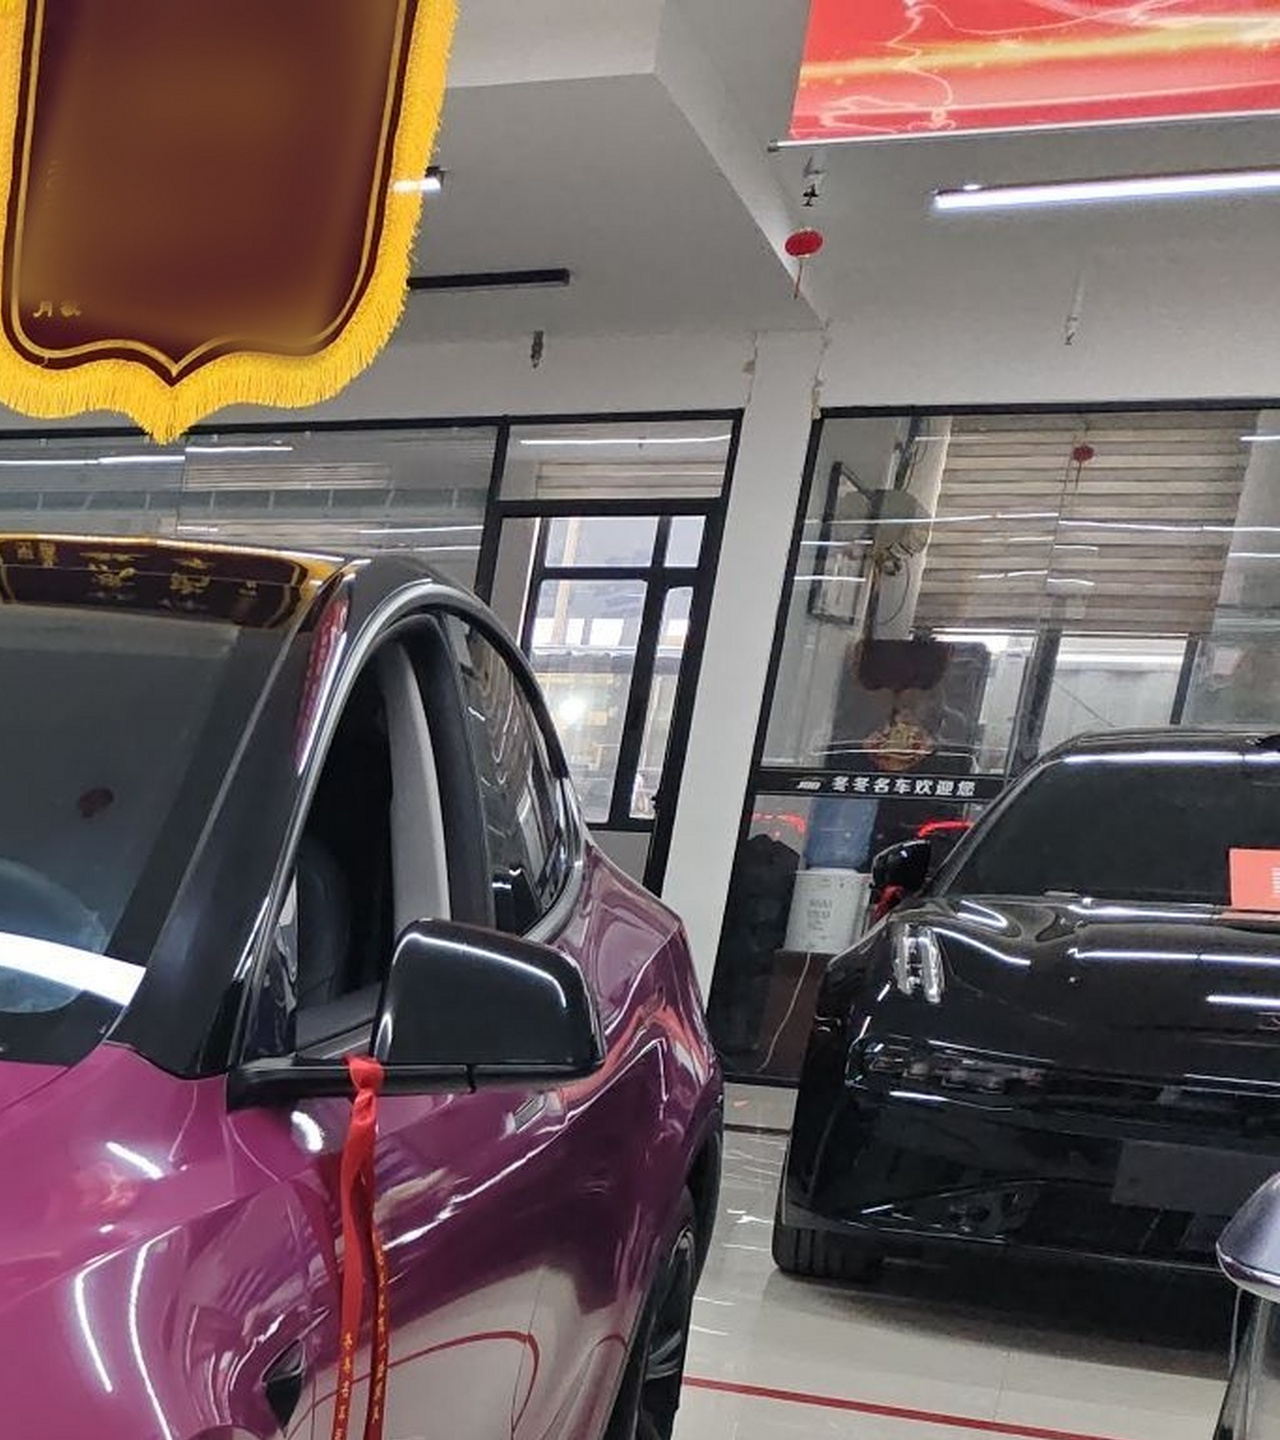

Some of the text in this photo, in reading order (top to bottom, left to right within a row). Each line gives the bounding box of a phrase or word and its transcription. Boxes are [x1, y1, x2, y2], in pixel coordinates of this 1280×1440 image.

[832, 775, 976, 797] 冬冬名车欢迎您
